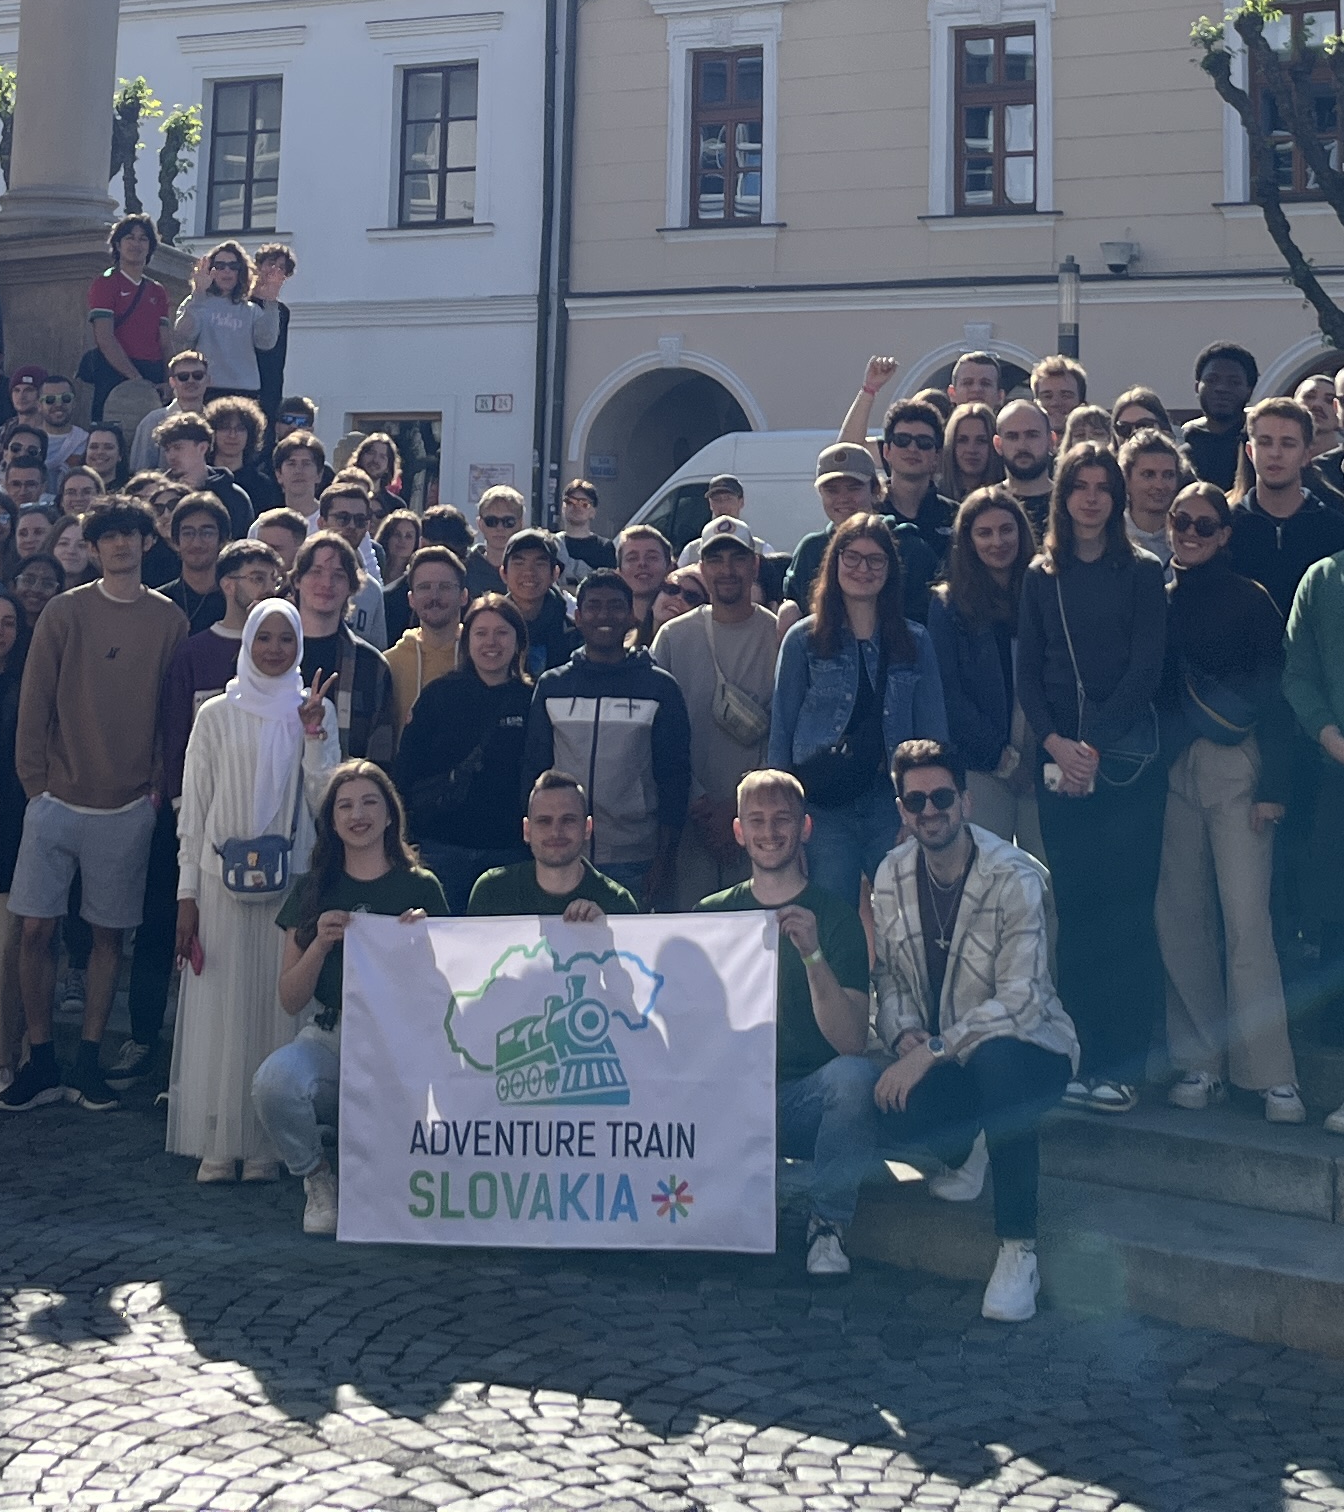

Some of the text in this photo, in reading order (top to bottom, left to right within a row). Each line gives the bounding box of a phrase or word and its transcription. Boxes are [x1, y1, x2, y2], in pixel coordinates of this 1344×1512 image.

[409, 1120, 695, 1159] ADVENTURE TRAIN
[408, 1169, 639, 1223] SLOVAKIA
